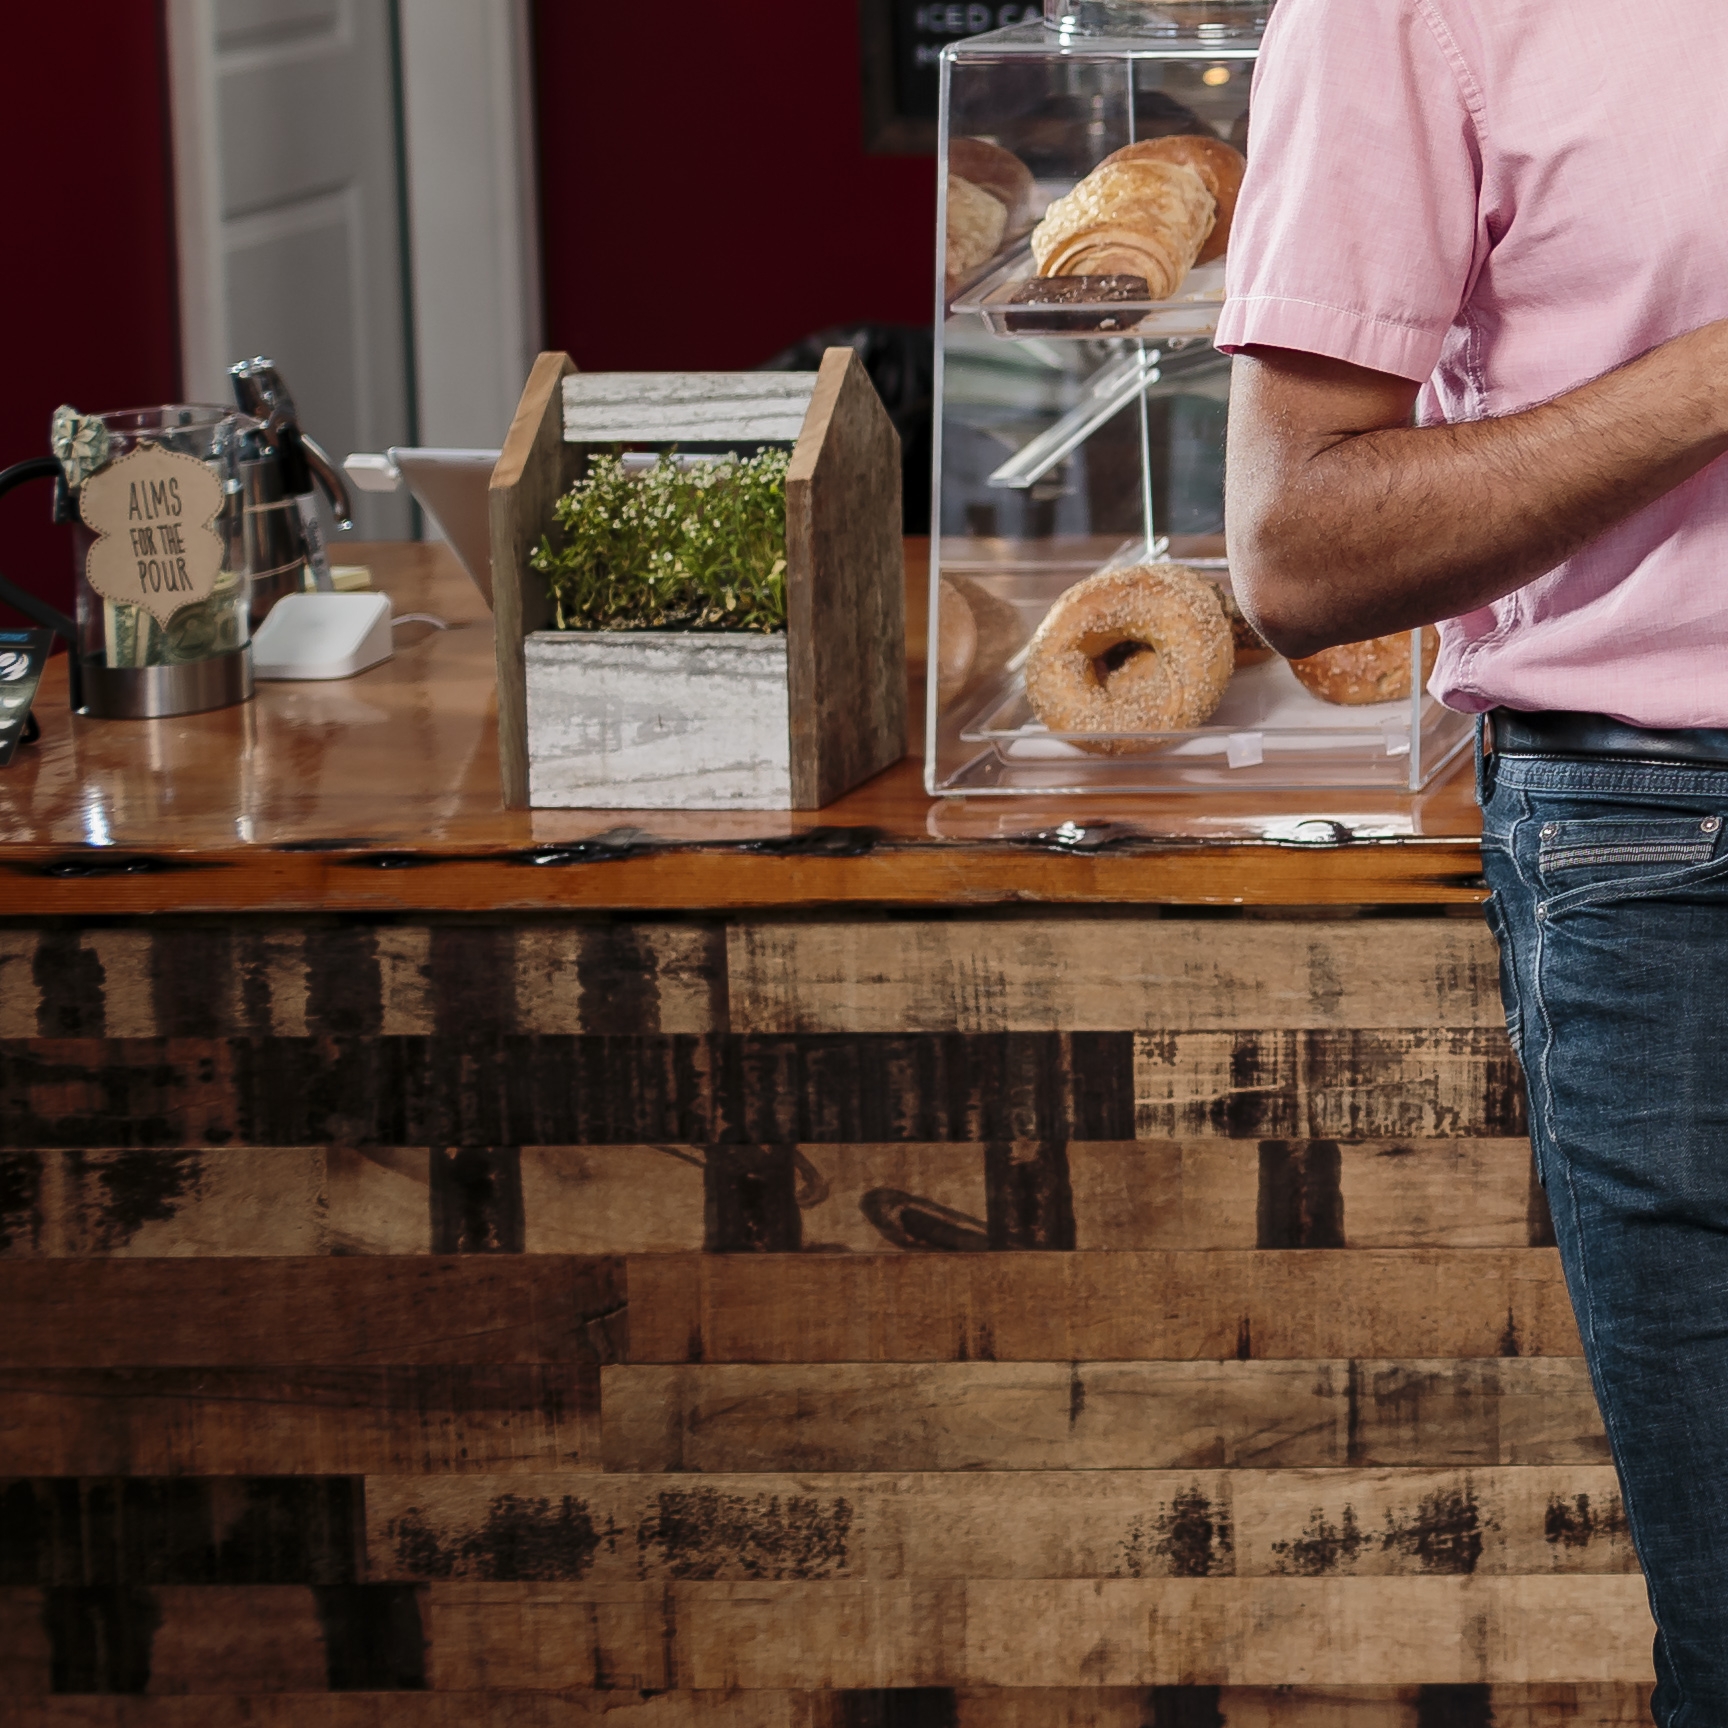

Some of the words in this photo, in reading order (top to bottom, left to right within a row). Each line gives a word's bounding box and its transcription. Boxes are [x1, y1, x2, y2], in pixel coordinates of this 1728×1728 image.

[129, 477, 182, 521] ALMS
[130, 527, 157, 558] FOR
[160, 523, 186, 556] THE
[137, 557, 194, 594] POUR
